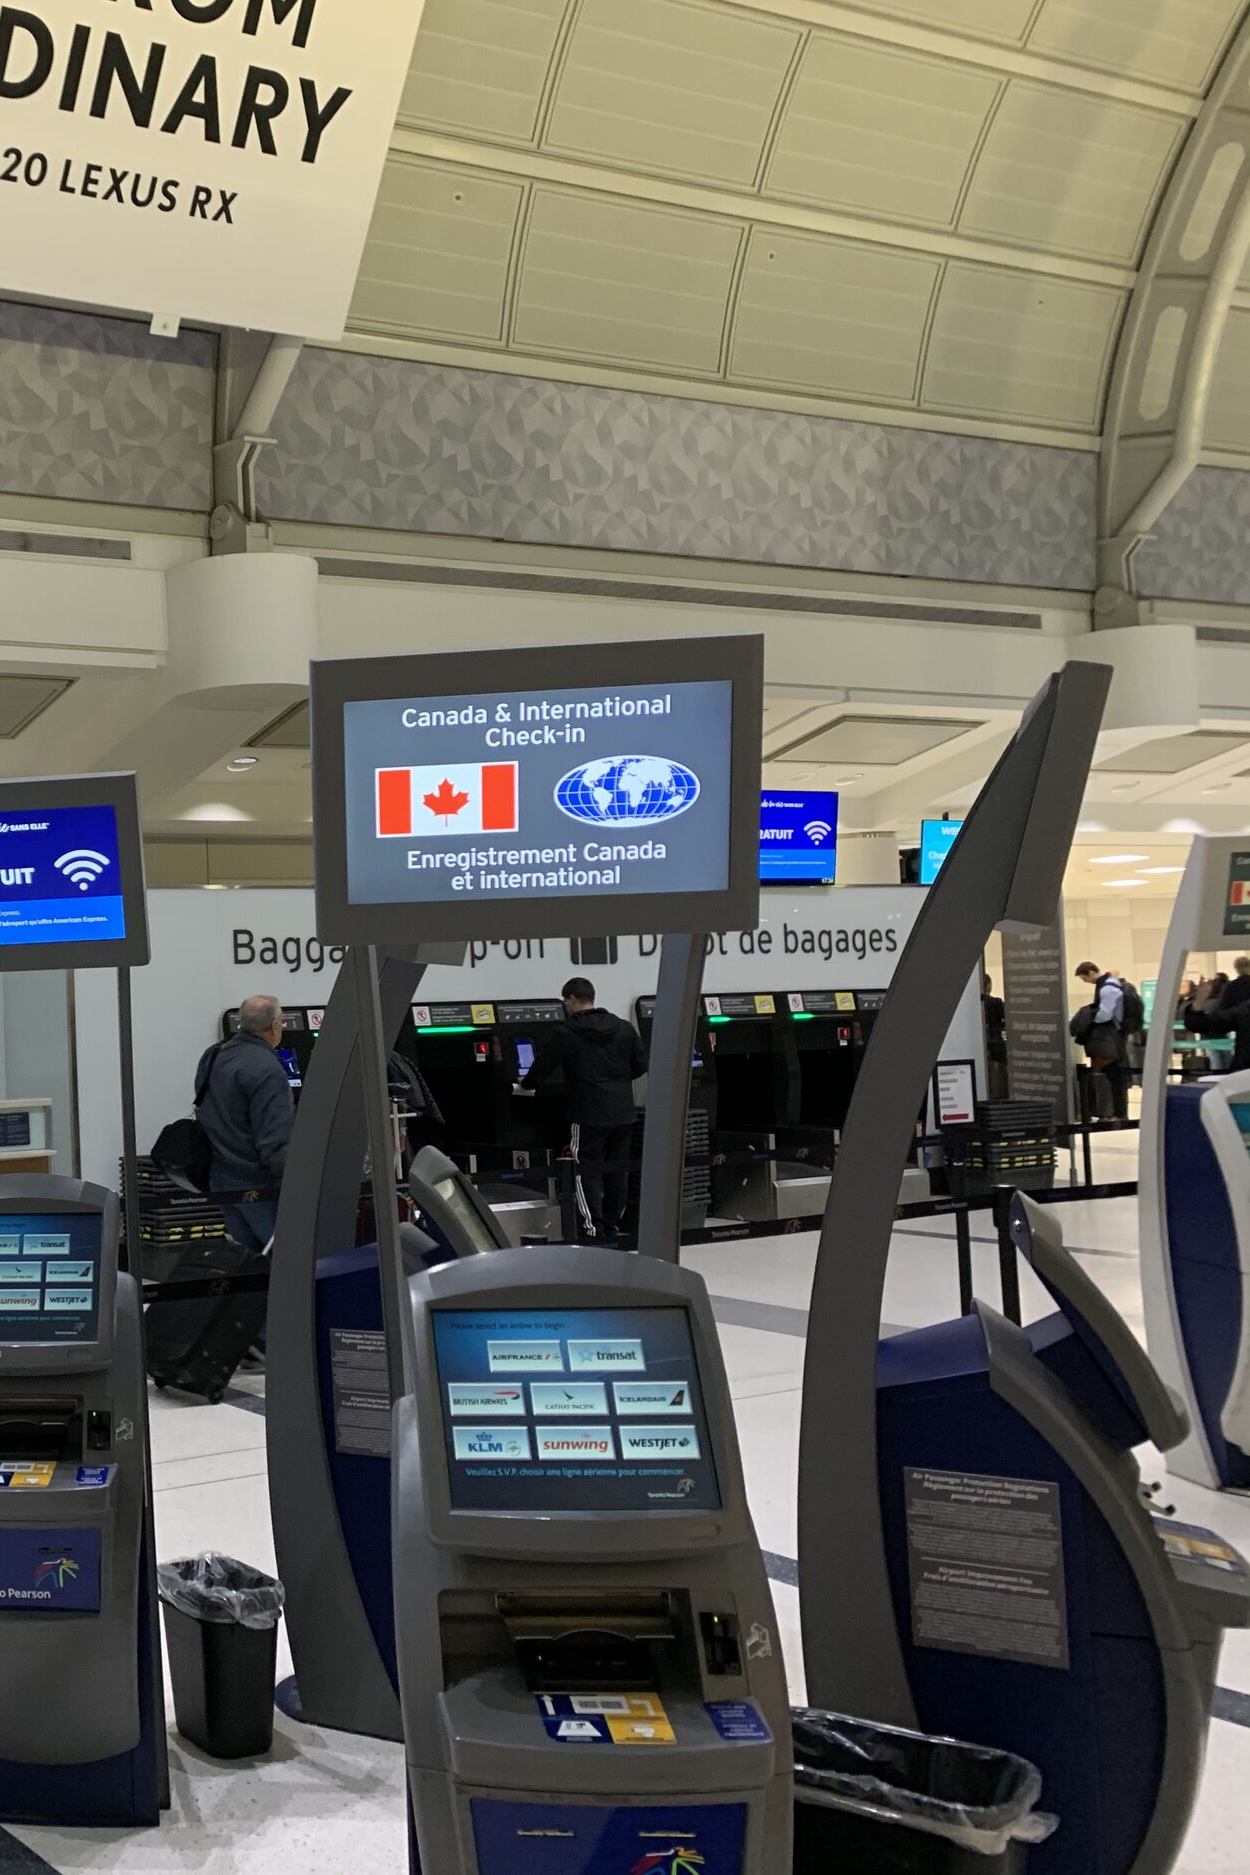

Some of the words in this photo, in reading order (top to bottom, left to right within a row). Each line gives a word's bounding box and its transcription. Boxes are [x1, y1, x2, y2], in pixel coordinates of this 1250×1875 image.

[58, 158, 179, 213] LEXUS
[188, 186, 238, 225] RX
[402, 705, 488, 728] Canada
[495, 703, 511, 723] &
[519, 694, 671, 722] International
[485, 725, 586, 747] Check-in
[760, 829, 794, 839] RATUIT
[408, 843, 577, 871] Enregistrement
[583, 840, 666, 862] Canada
[451, 872, 474, 890] et
[480, 866, 621, 889] international
[783, 923, 898, 961] bagages
[233, 929, 349, 973] Bagga
[49, 1296, 81, 1306] WESTJET
[597, 1350, 637, 1361] transat
[453, 1398, 479, 1406] BRITISH
[468, 1443, 503, 1453] KLM
[543, 1440, 609, 1453] sunwing
[628, 1439, 678, 1450] WESTJET
[465, 1468, 496, 1476] Veuillez
[520, 1468, 545, 1476] choisir
[562, 1468, 582, 1478] ligne
[618, 1469, 637, 1478] pour
[8, 1588, 51, 1599] Pearson
